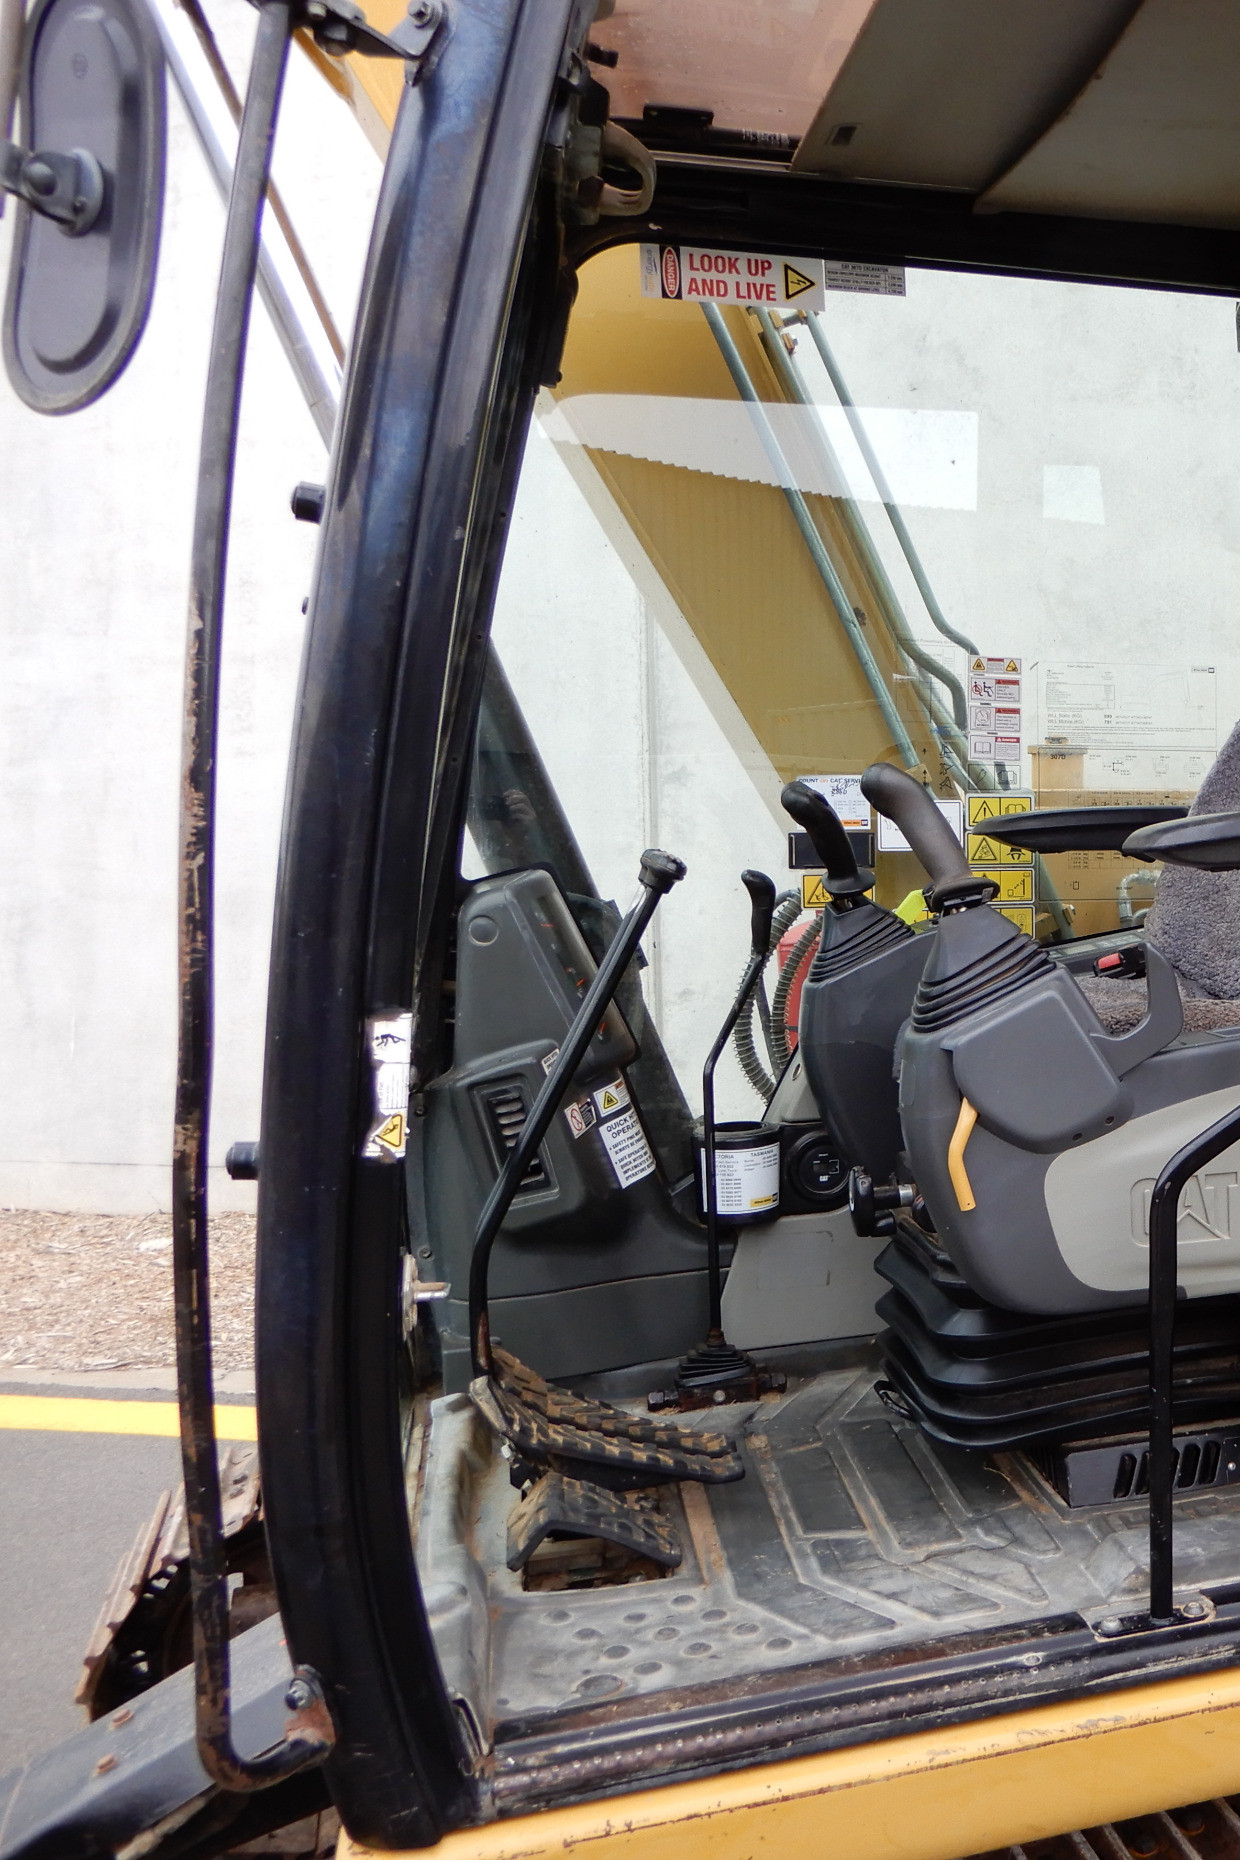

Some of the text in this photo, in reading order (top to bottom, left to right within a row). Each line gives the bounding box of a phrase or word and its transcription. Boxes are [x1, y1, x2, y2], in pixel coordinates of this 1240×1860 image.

[666, 253, 677, 292] DANGER
[688, 252, 773, 277] LOOK UP
[687, 277, 777, 301] AND LIVE
[606, 1117, 629, 1132] QUICK
[611, 1120, 639, 1139] OPERAT
